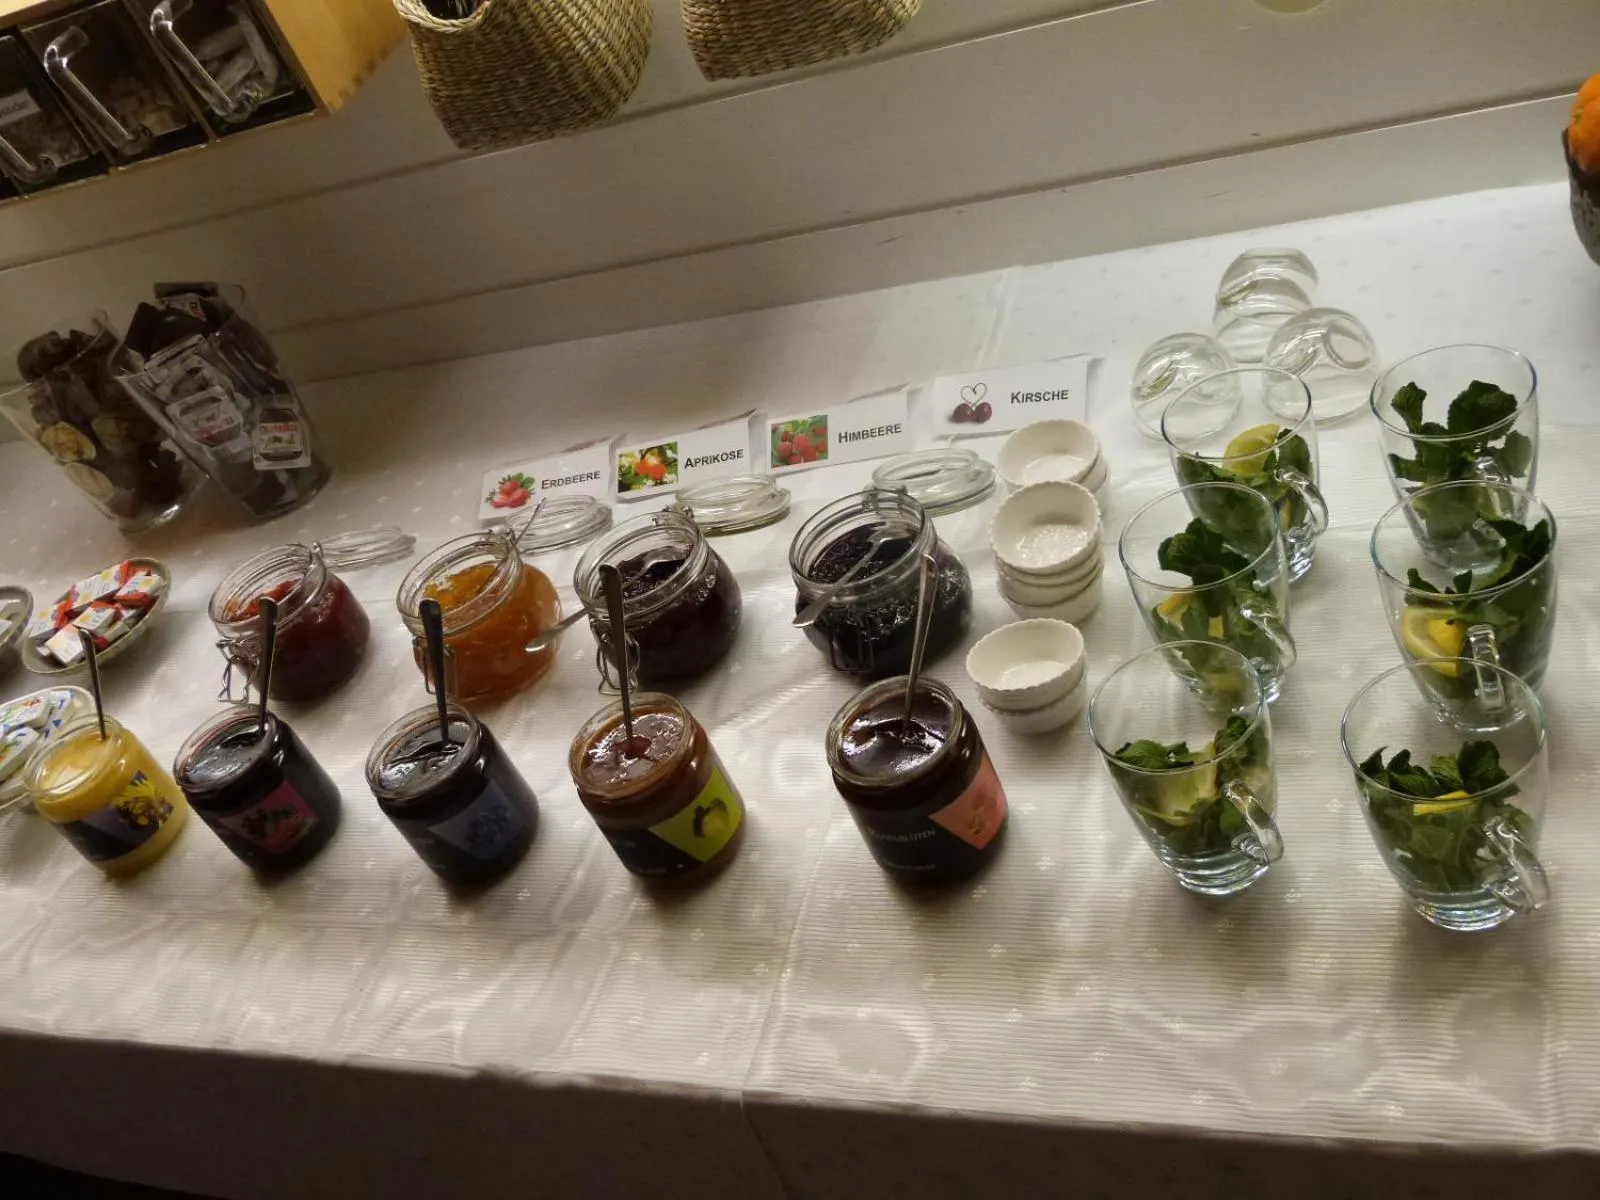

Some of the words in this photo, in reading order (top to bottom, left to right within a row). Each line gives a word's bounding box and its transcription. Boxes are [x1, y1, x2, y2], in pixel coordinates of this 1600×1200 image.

[1010, 389, 1070, 405] KIRSCHE
[837, 422, 903, 444] HIMBEERE
[684, 448, 744, 469] APRIKOSE
[541, 470, 601, 490] ERDBEERE
